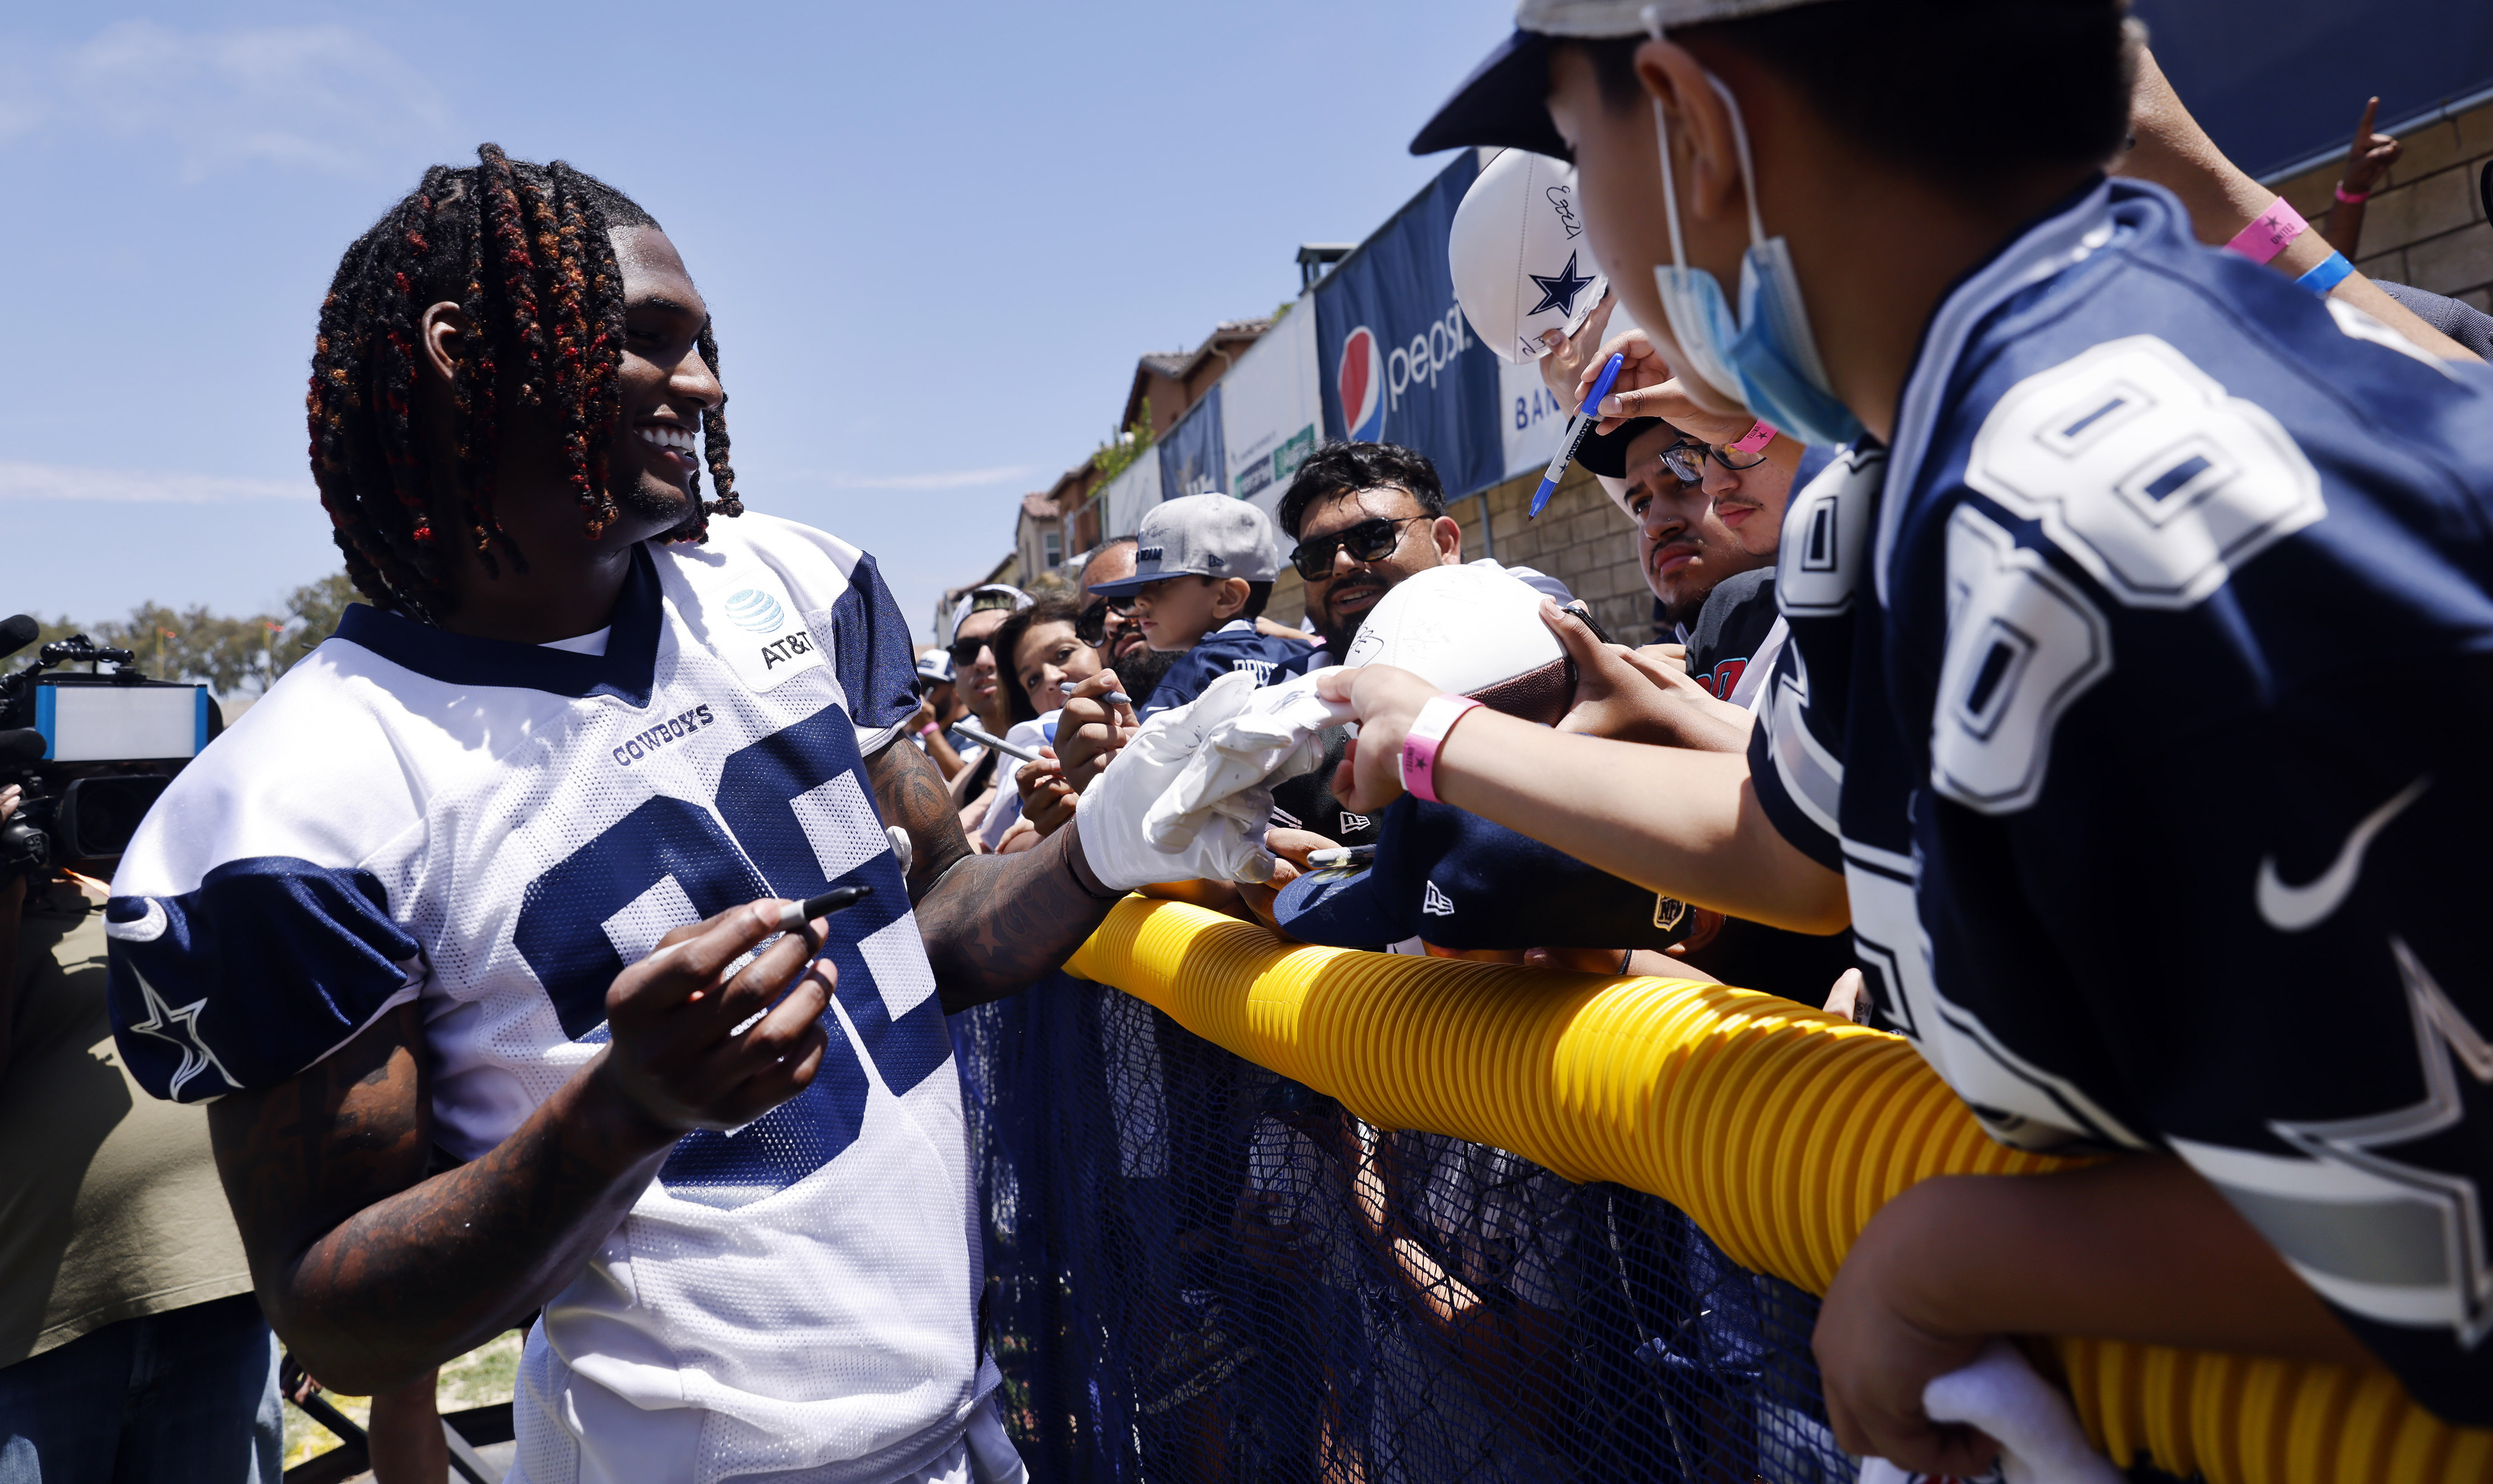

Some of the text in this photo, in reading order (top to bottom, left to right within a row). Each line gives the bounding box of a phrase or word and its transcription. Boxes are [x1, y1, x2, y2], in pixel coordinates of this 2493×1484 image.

[2271, 222, 2295, 245] UNITED
[1388, 290, 1465, 413] pepsi
[1516, 387, 1561, 430] BAN
[1565, 418, 1593, 461] COWBOYS
[1747, 426, 1761, 439] UNITED
[761, 631, 814, 670] AT&T
[612, 703, 715, 767] COWBOYS
